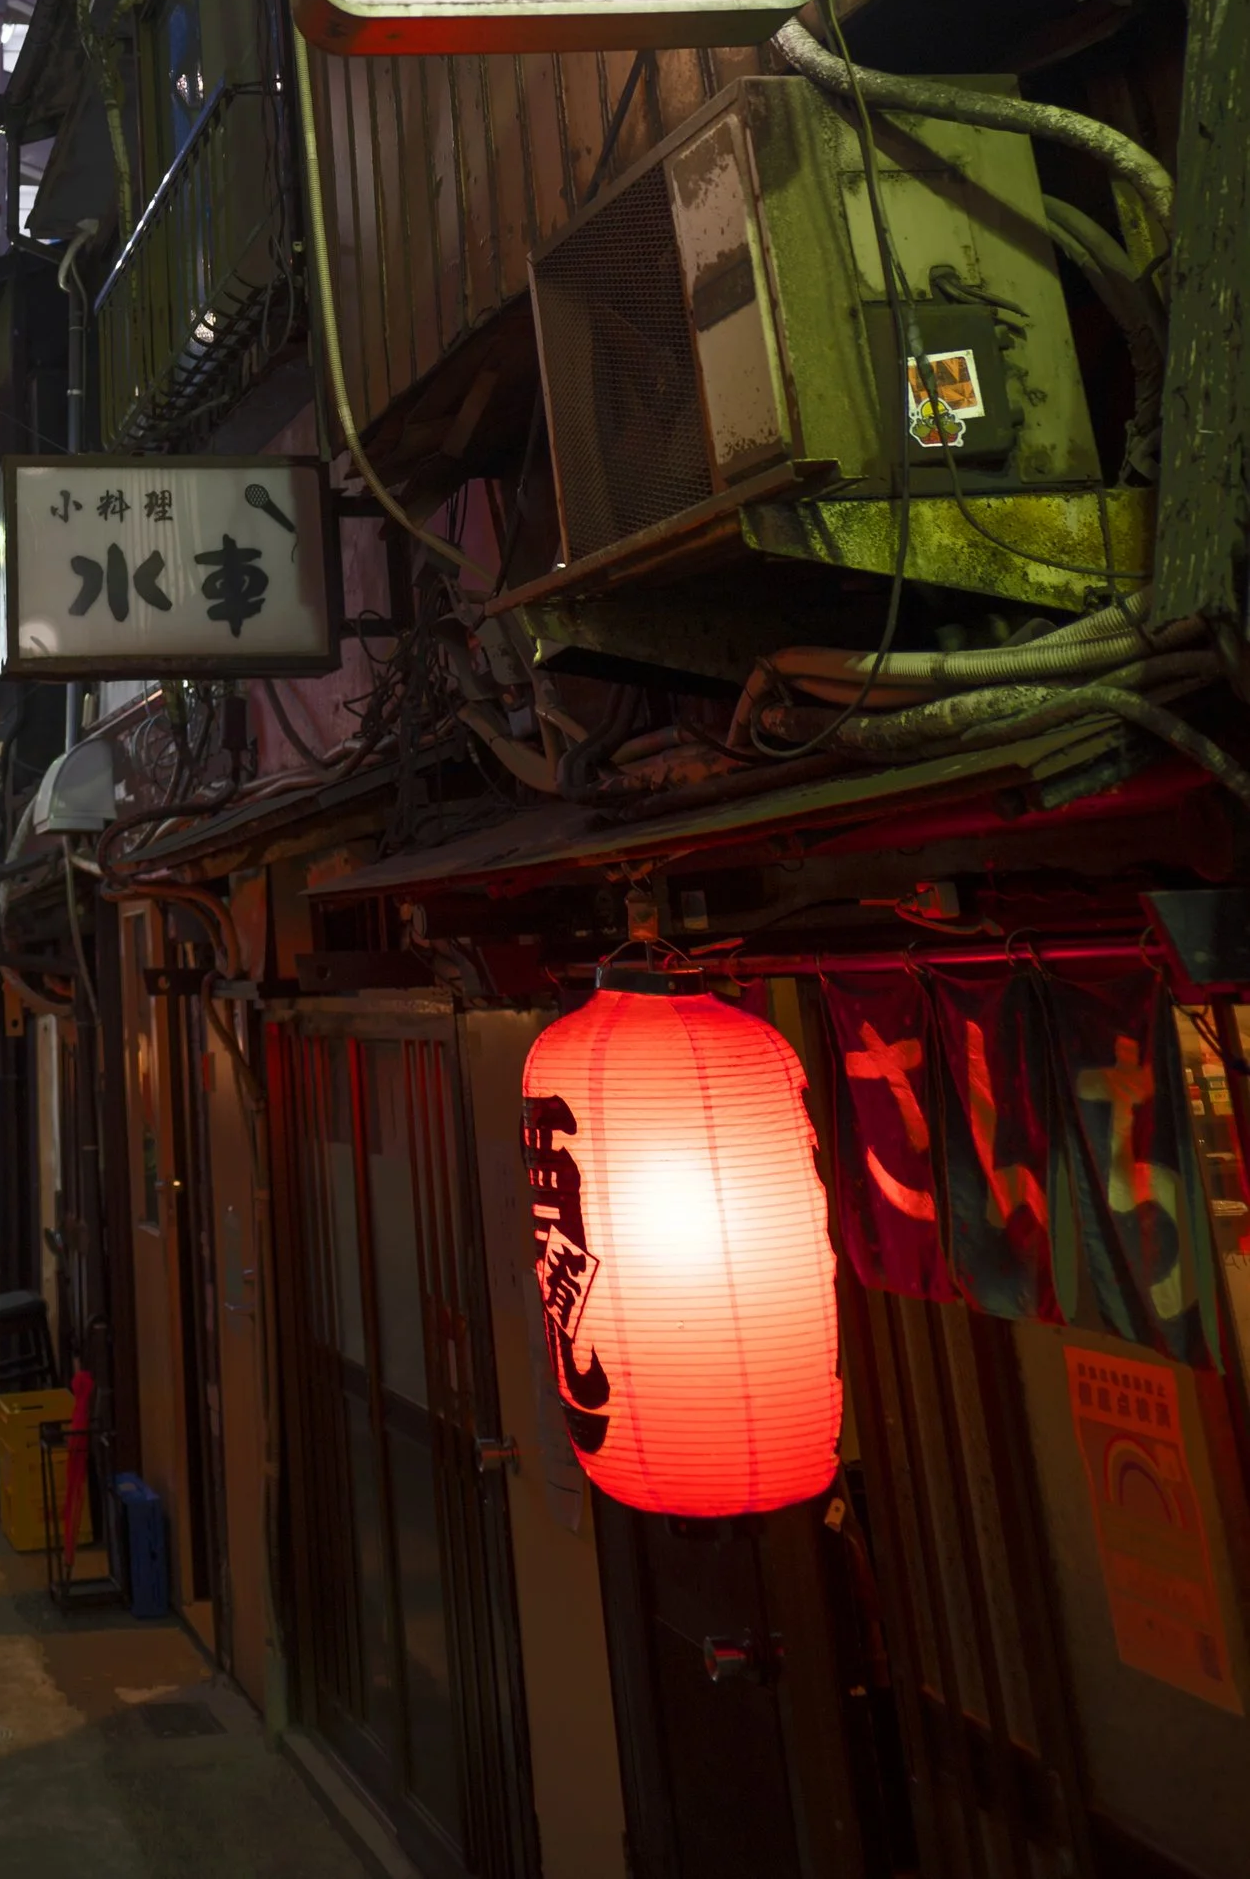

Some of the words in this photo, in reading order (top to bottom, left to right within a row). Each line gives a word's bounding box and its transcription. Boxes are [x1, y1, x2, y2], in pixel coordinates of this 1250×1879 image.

[50, 489, 174, 523] 小料理
[68, 533, 269, 639] 水車
